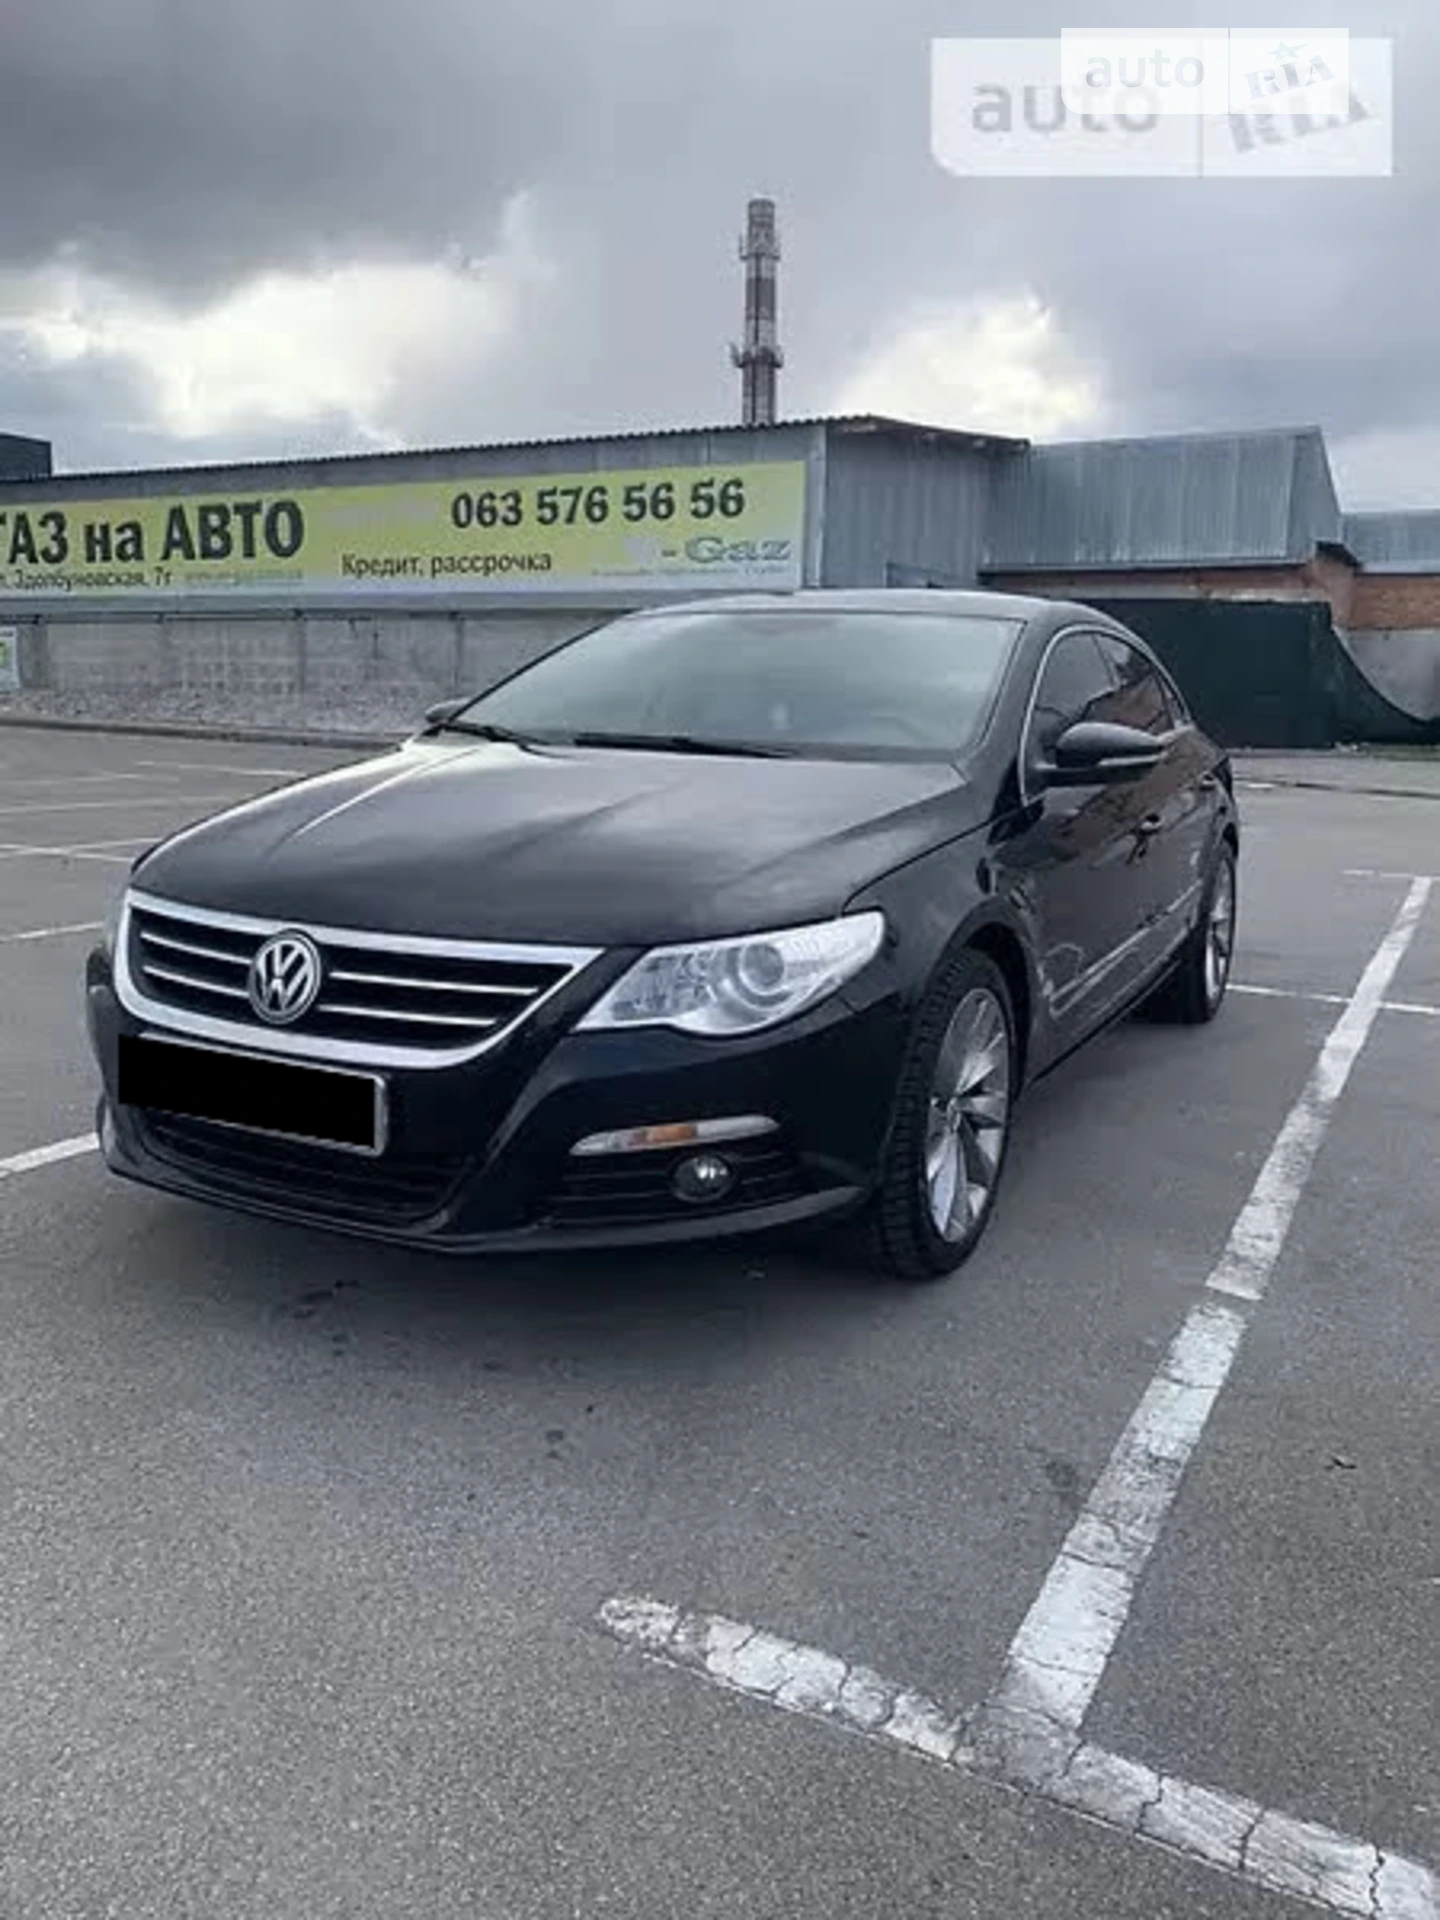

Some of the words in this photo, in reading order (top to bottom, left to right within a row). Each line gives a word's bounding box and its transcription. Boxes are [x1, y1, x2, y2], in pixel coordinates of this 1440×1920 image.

[83, 520, 146, 563] на
[159, 499, 305, 562] АВТО
[451, 488, 523, 529] 063
[536, 484, 609, 526] 576
[622, 481, 676, 522] 56
[689, 476, 745, 519] 56
[430, 552, 552, 580] рассрочка
[253, 936, 316, 1019] VW
